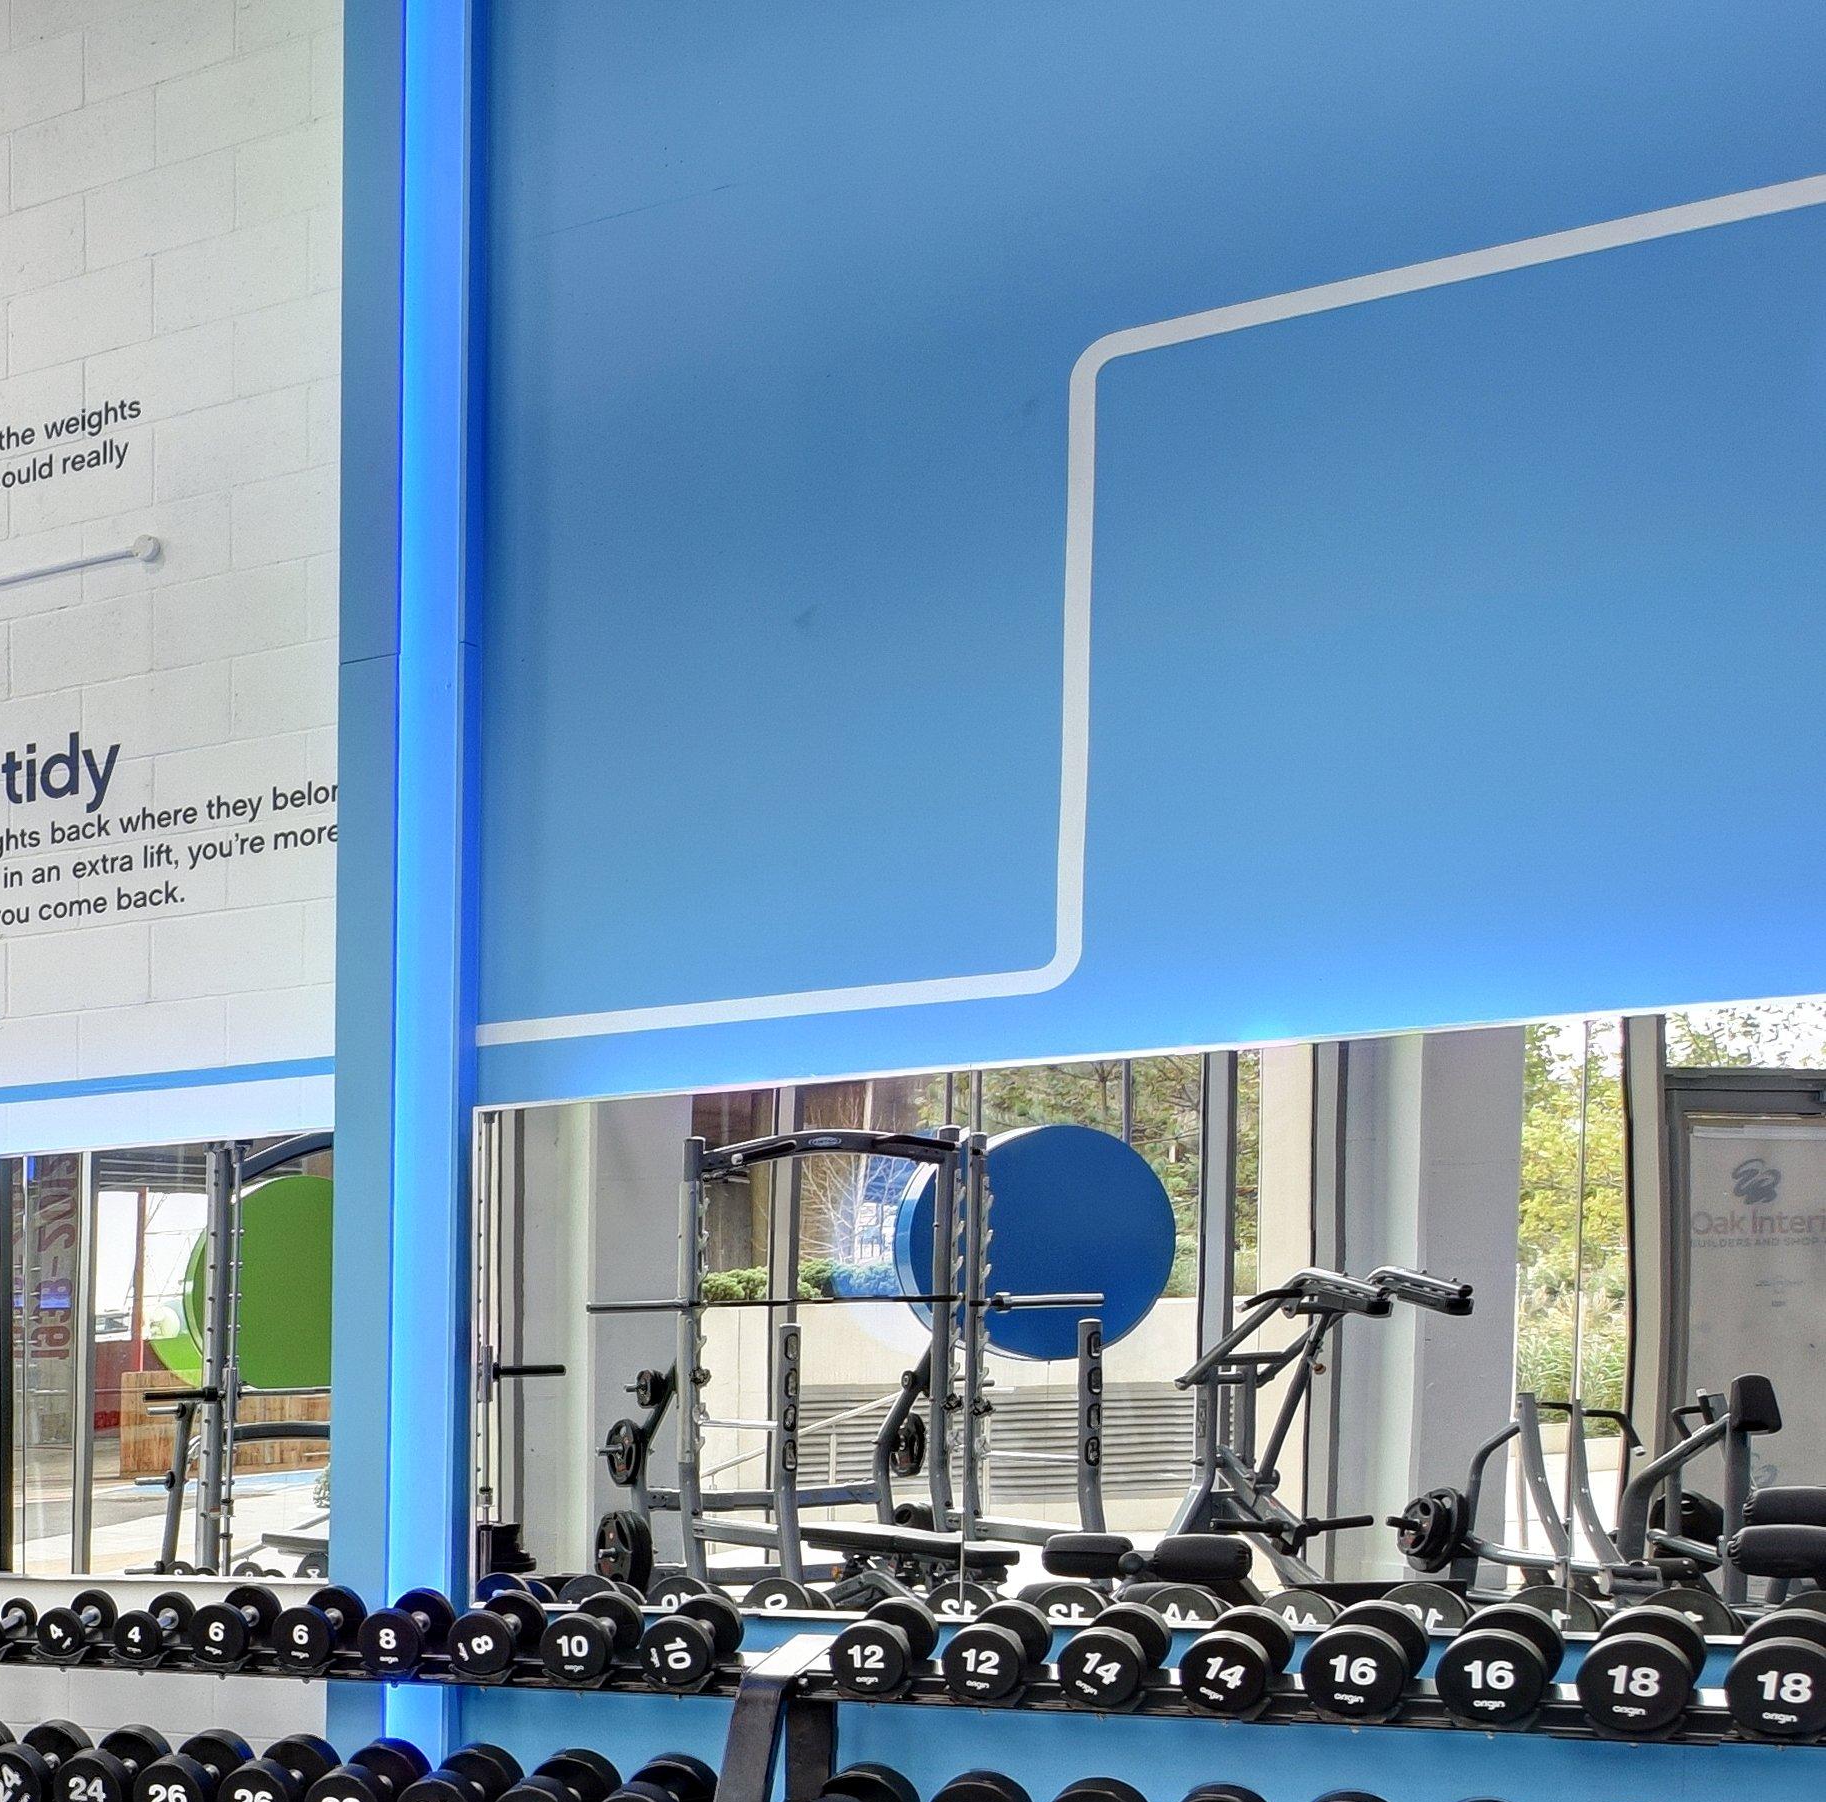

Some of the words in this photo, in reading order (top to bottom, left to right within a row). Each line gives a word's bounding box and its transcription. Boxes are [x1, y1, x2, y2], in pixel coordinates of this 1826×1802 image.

[43, 400, 142, 440] weights
[62, 438, 130, 475] really
[1, 731, 122, 815] tidy
[50, 813, 111, 845] back
[118, 806, 198, 834] where
[205, 795, 263, 823] they
[3, 866, 23, 889] in
[31, 864, 61, 885] an
[72, 853, 133, 880] extra
[143, 842, 179, 870] lift,
[187, 832, 266, 871] you're
[273, 824, 338, 852] more
[38, 896, 108, 921] come
[116, 880, 185, 911] back.
[1693, 1211, 1745, 1235] Oak
[49, 1623, 64, 1640] 4
[127, 1626, 142, 1643] 4
[208, 1621, 225, 1642] 6
[292, 1624, 309, 1645] 6
[379, 1628, 397, 1650] 8
[471, 1634, 494, 1655] 8
[556, 1635, 589, 1658] 10
[663, 1636, 692, 1670] 10
[847, 1644, 885, 1669] 12
[961, 1648, 1000, 1676] 12
[1076, 1652, 1122, 1688] 14
[1203, 1656, 1246, 1691] 14
[1328, 1654, 1378, 1686] 16
[1463, 1659, 1515, 1690] 16
[1607, 1664, 1660, 1697] 18
[1756, 1670, 1812, 1704] 18
